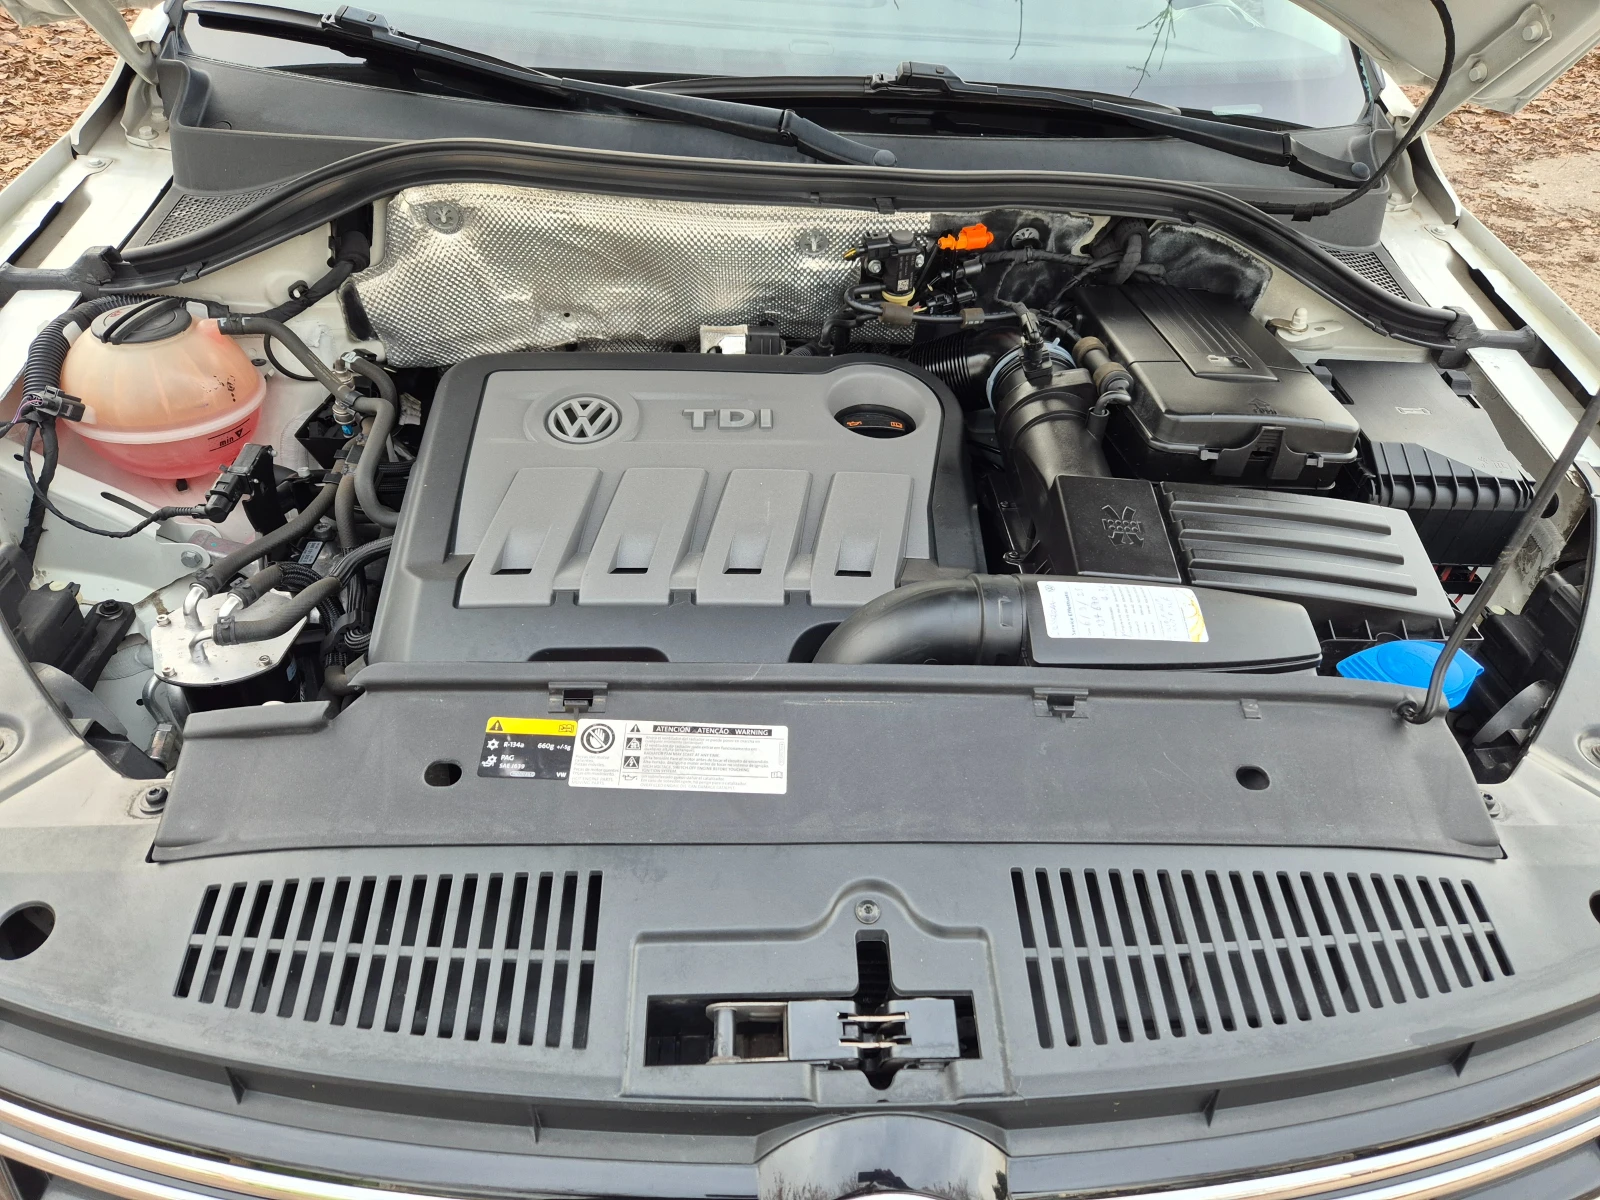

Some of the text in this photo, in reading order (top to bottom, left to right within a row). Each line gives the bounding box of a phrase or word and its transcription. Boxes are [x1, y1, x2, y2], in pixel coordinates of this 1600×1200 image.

[682, 408, 773, 430] TDI
[220, 436, 234, 446] min
[537, 742, 554, 750] 660g
